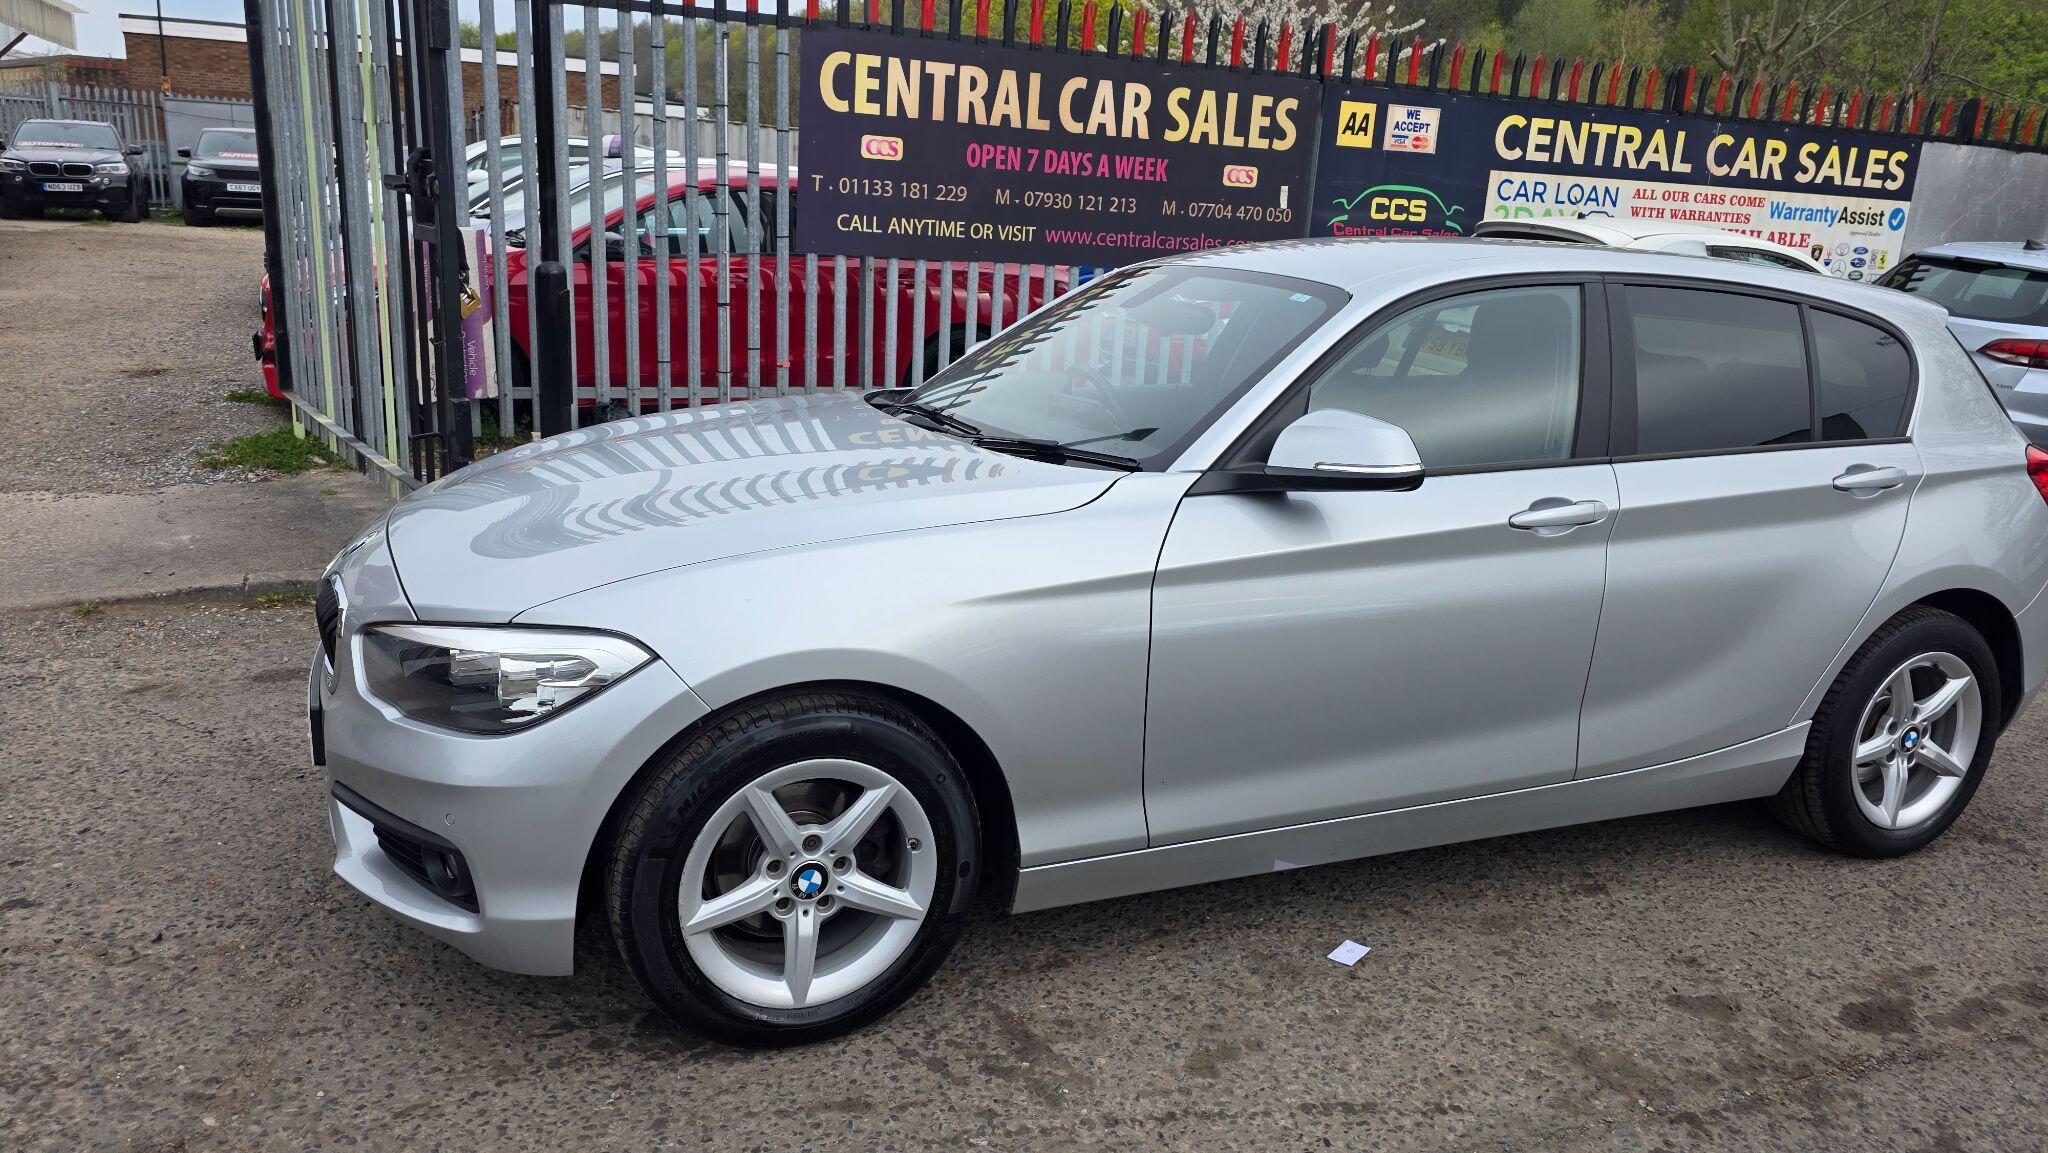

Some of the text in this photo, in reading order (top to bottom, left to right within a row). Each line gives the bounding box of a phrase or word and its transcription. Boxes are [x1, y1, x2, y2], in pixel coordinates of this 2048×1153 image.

[820, 51, 1299, 151] CENTRAL CAR SALES
[1342, 111, 1370, 137] AA
[1406, 108, 1421, 121] WE
[1393, 120, 1431, 134] ACCEPT
[865, 138, 899, 158] CCS
[1494, 114, 1909, 191] CENTRAL CAR SALES
[966, 143, 1169, 182] OPEN 7 DAYS A WEEK
[1226, 168, 1254, 185] CCS
[838, 177, 893, 197] 01133
[900, 181, 928, 200] 181
[935, 184, 968, 201] 229
[1496, 178, 1620, 208] CAR LOAN
[1632, 187, 1766, 208] ALL OUR CARS COME
[1024, 191, 1072, 209] 07930
[1078, 195, 1103, 211] 121
[1109, 197, 1137, 214] 213
[1188, 202, 1232, 219] 07704
[1236, 205, 1263, 221] 470
[1266, 207, 1292, 223] 050
[1370, 196, 1428, 222] CCS
[1630, 206, 1751, 225] WITH WARRANTIES
[836, 213, 1255, 251] CALL ANYTIME OR VISIT www.centralcarsalesc
[1333, 221, 1387, 237] Central
[1391, 228, 1418, 237] Car
[467, 340, 478, 376] Vehicle
